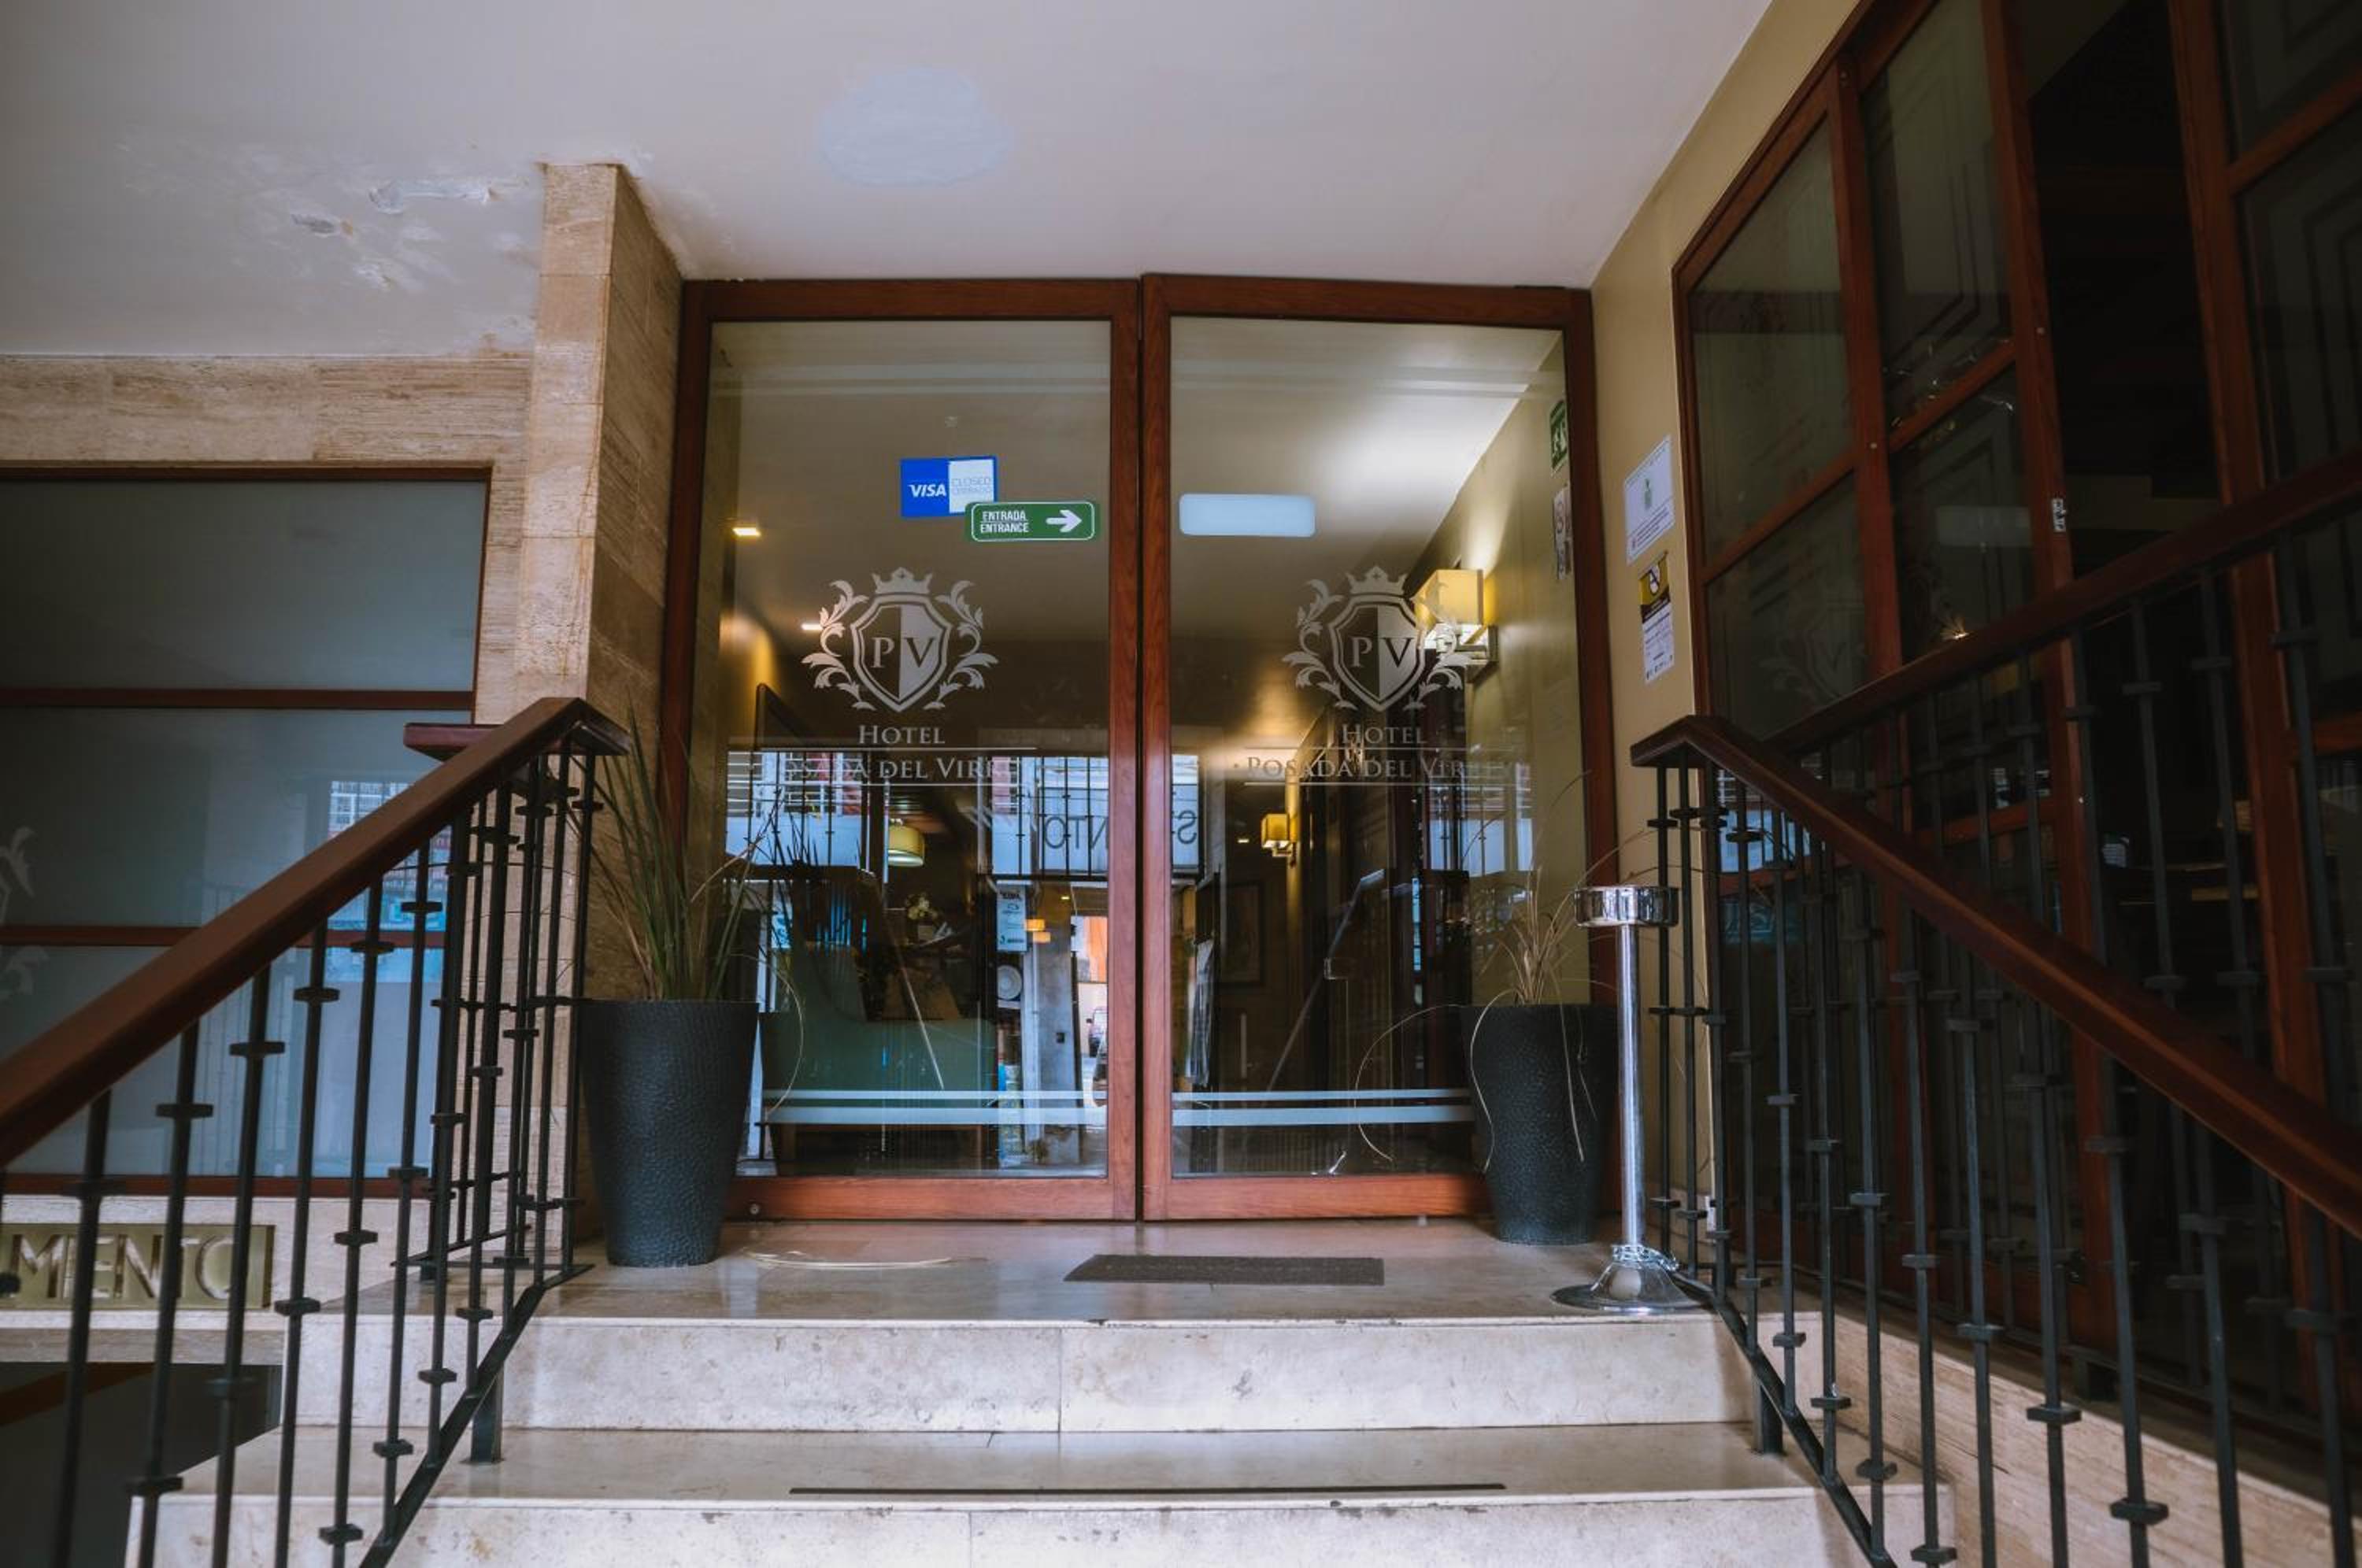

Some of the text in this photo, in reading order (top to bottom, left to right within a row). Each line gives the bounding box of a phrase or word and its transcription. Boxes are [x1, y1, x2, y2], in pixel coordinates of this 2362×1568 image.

[909, 484, 947, 497] VISA
[982, 511, 1027, 521] ENTRADA
[980, 522, 1029, 533] ENTRANCE
[858, 724, 946, 744] HOTEL
[1342, 723, 1428, 744] HOTEL
[878, 760, 928, 778] DEL
[1247, 756, 1353, 778] POSADA
[1364, 759, 1412, 778] DEL
